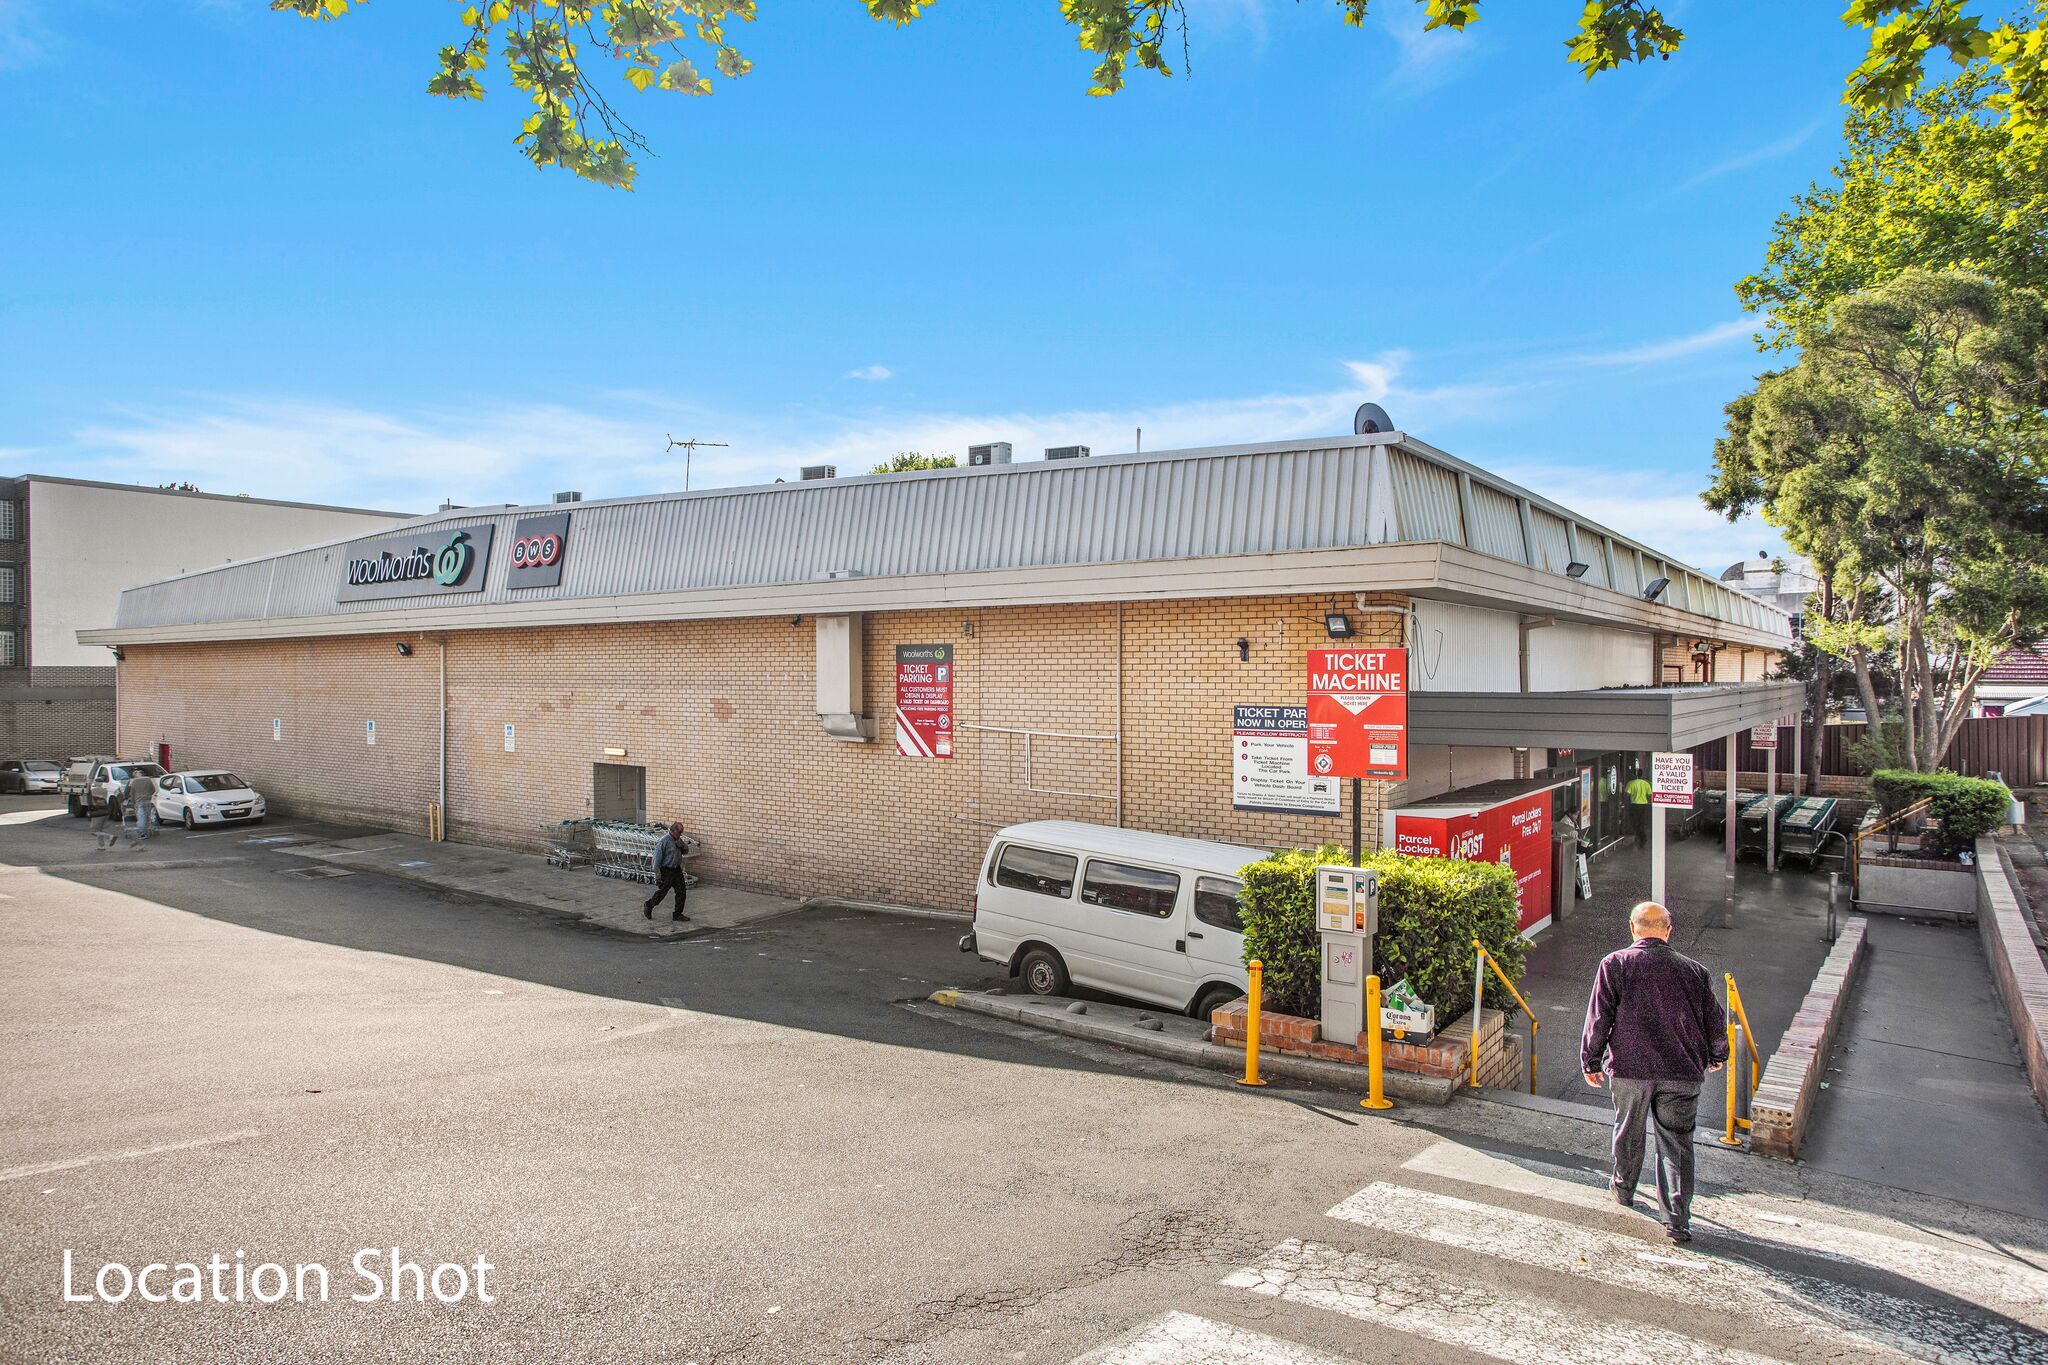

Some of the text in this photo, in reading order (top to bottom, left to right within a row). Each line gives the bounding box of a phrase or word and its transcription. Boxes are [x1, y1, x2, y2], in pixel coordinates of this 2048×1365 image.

[516, 544, 552, 558] BWS
[347, 546, 431, 584] woolworths
[1325, 654, 1386, 671] TICKET
[904, 665, 928, 673] TICKET
[937, 668, 946, 680] P
[900, 674, 932, 682] PARKING
[1312, 673, 1400, 690] MACHINE
[1237, 707, 1279, 718] TICKET
[1237, 719, 1261, 727] NOW
[1265, 719, 1274, 727] IN
[1512, 808, 1541, 827] Parcel Lockers
[1522, 825, 1531, 837] Free
[1399, 834, 1432, 844] Parcel
[1399, 844, 1440, 854] Lockers
[1462, 833, 1484, 860] POST
[1386, 1011, 1411, 1021] Corona
